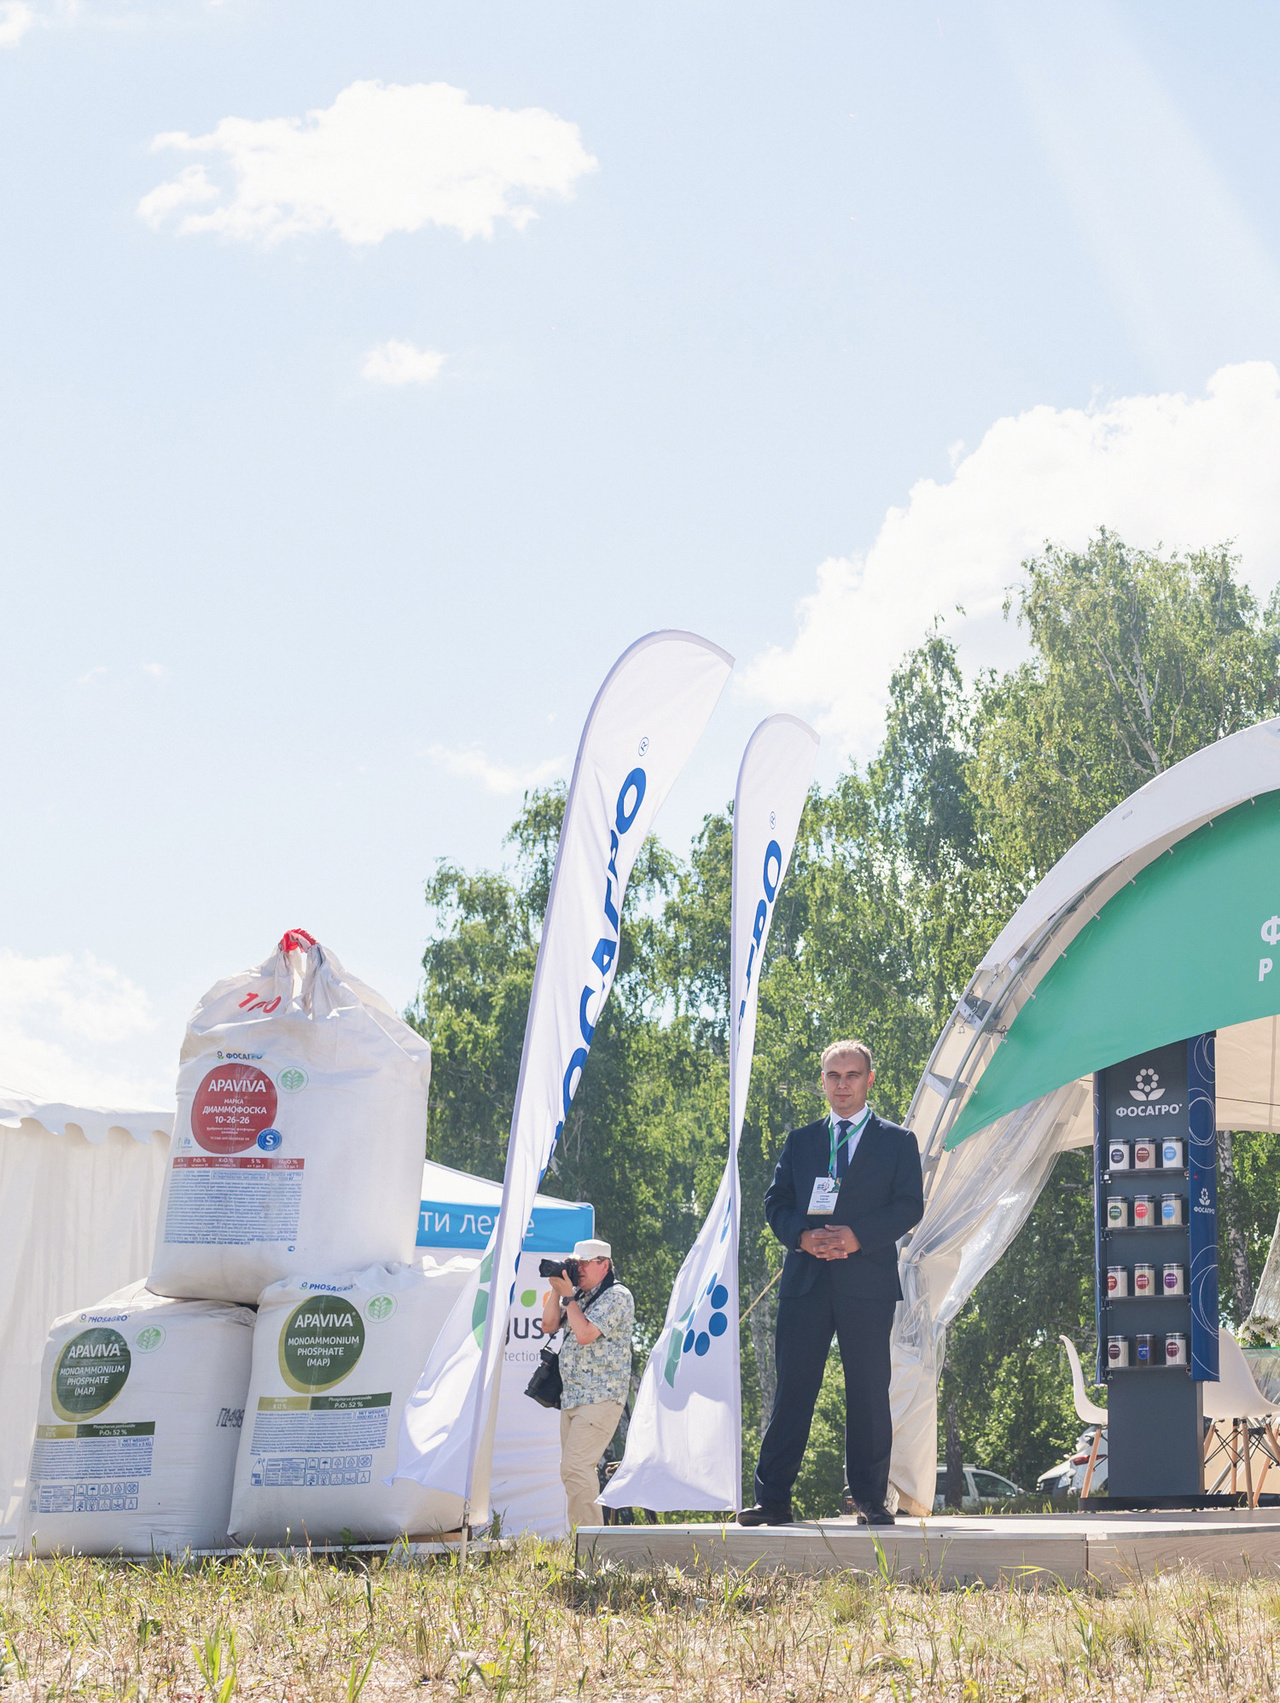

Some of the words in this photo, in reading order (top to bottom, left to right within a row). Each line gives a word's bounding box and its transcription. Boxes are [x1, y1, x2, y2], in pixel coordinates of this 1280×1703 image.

[208, 1078, 267, 1093] APAVIVA
[202, 1104, 268, 1115] ДИАММОФОСКА
[1116, 1104, 1180, 1117] ФОСАГРО
[214, 1115, 250, 1125] 10-26-26
[265, 1134, 274, 1146] S
[295, 1313, 353, 1328] APAVIVA
[288, 1335, 360, 1346] MONOAMMONIUM
[68, 1343, 120, 1359] APAVIVA
[297, 1347, 344, 1356] PHOSPHATE
[306, 1357, 331, 1368] (MAP)
[60, 1365, 125, 1376] MONOAMMONIUM
[67, 1376, 109, 1385] PHOSPHATE
[74, 1386, 96, 1396] (MAP)
